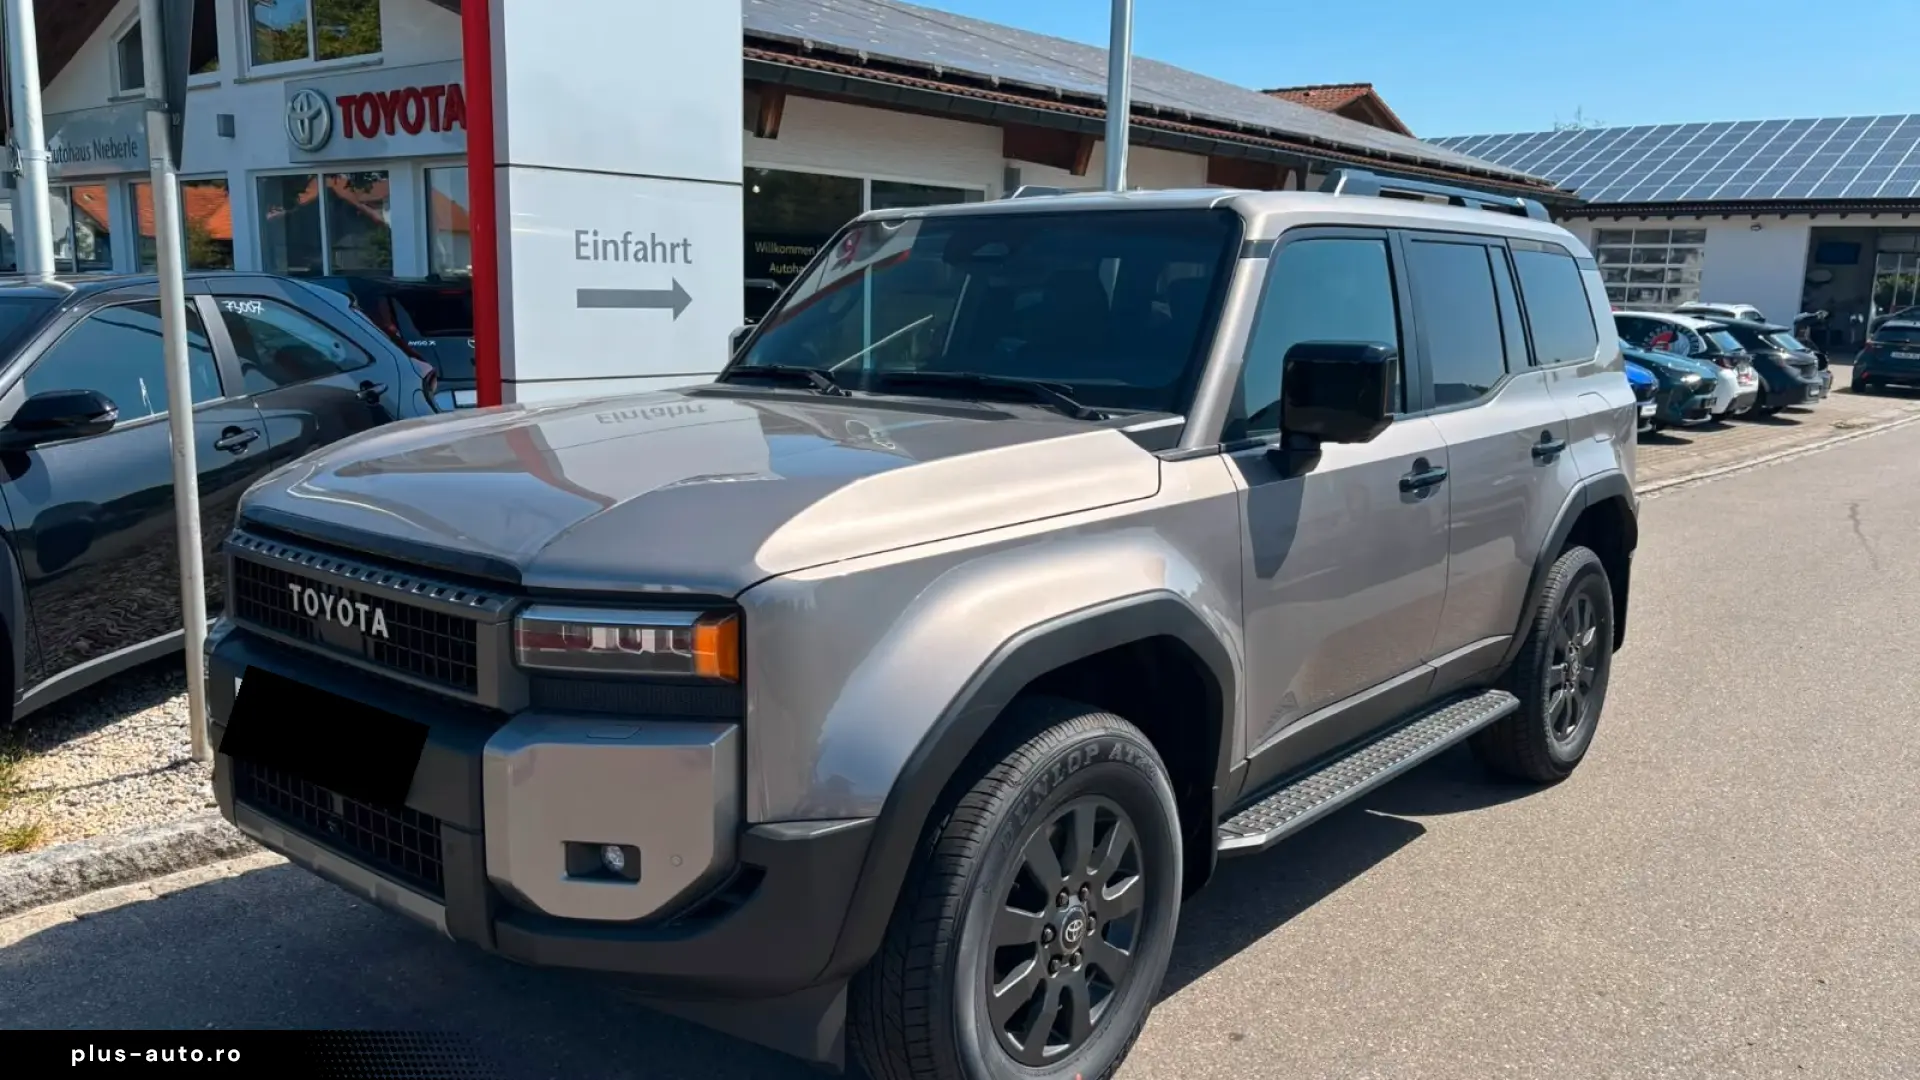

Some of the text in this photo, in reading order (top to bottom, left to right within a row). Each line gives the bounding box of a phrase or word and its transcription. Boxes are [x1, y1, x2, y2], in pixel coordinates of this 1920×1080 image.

[335, 83, 467, 139] TOYOTA
[93, 134, 138, 160] Nieberle
[575, 228, 692, 265] Einfahrt
[755, 242, 815, 255] Willkommen
[288, 583, 389, 638] TOYOTA
[1000, 742, 1100, 850] DUNLOP
